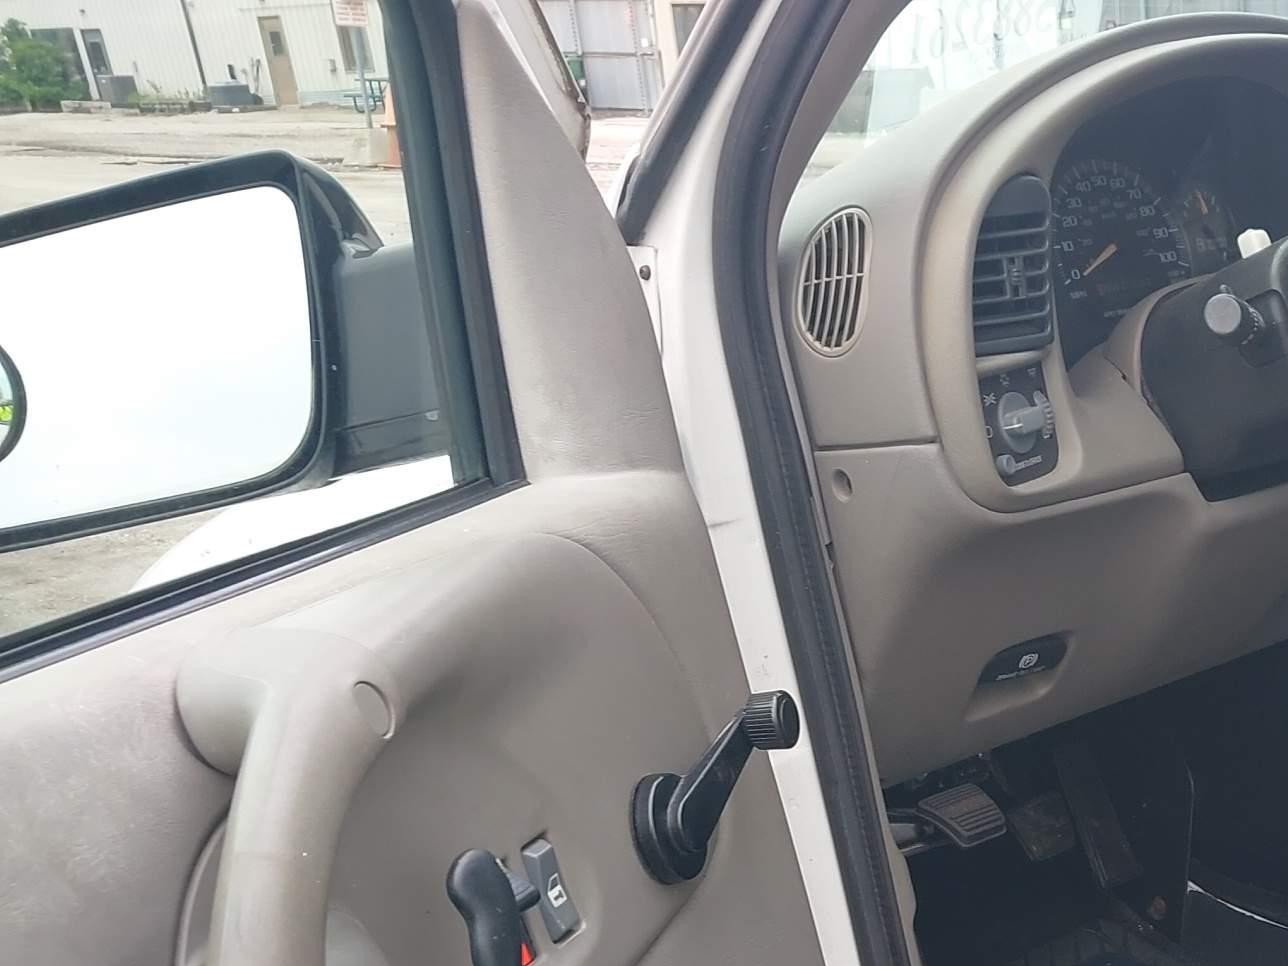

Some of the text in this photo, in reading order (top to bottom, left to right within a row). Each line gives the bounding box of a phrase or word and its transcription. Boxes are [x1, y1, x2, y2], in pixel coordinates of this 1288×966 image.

[1075, 180, 1091, 192] 40
[1126, 188, 1142, 200] 70
[1066, 197, 1082, 209] 30
[1139, 205, 1155, 217] 80
[1062, 215, 1078, 228] 20
[1153, 226, 1169, 239] 90
[1061, 240, 1074, 252] 10
[1159, 251, 1178, 264] 100
[1071, 268, 1081, 280] 0
